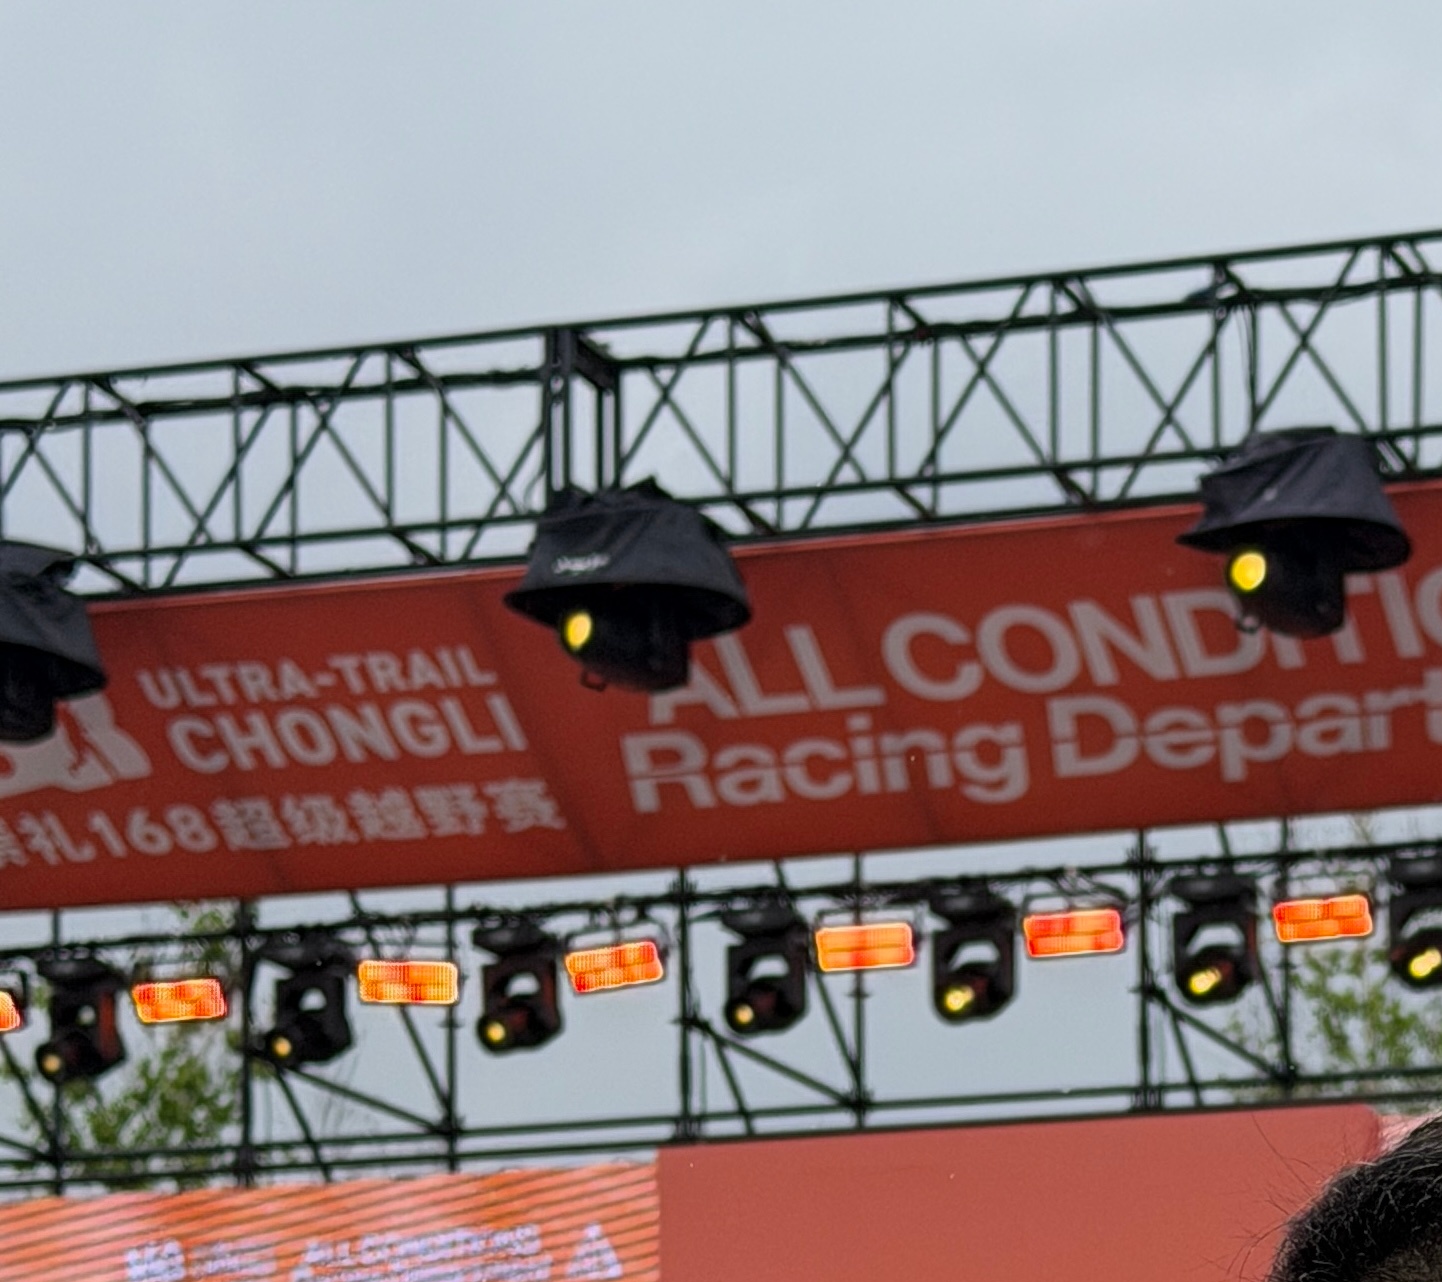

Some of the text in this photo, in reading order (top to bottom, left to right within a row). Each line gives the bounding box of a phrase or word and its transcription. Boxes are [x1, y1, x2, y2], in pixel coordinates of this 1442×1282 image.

[137, 645, 497, 710] ULTRA-TRAIL
[166, 694, 529, 774] CHONGLI
[621, 713, 1030, 814] Racing
